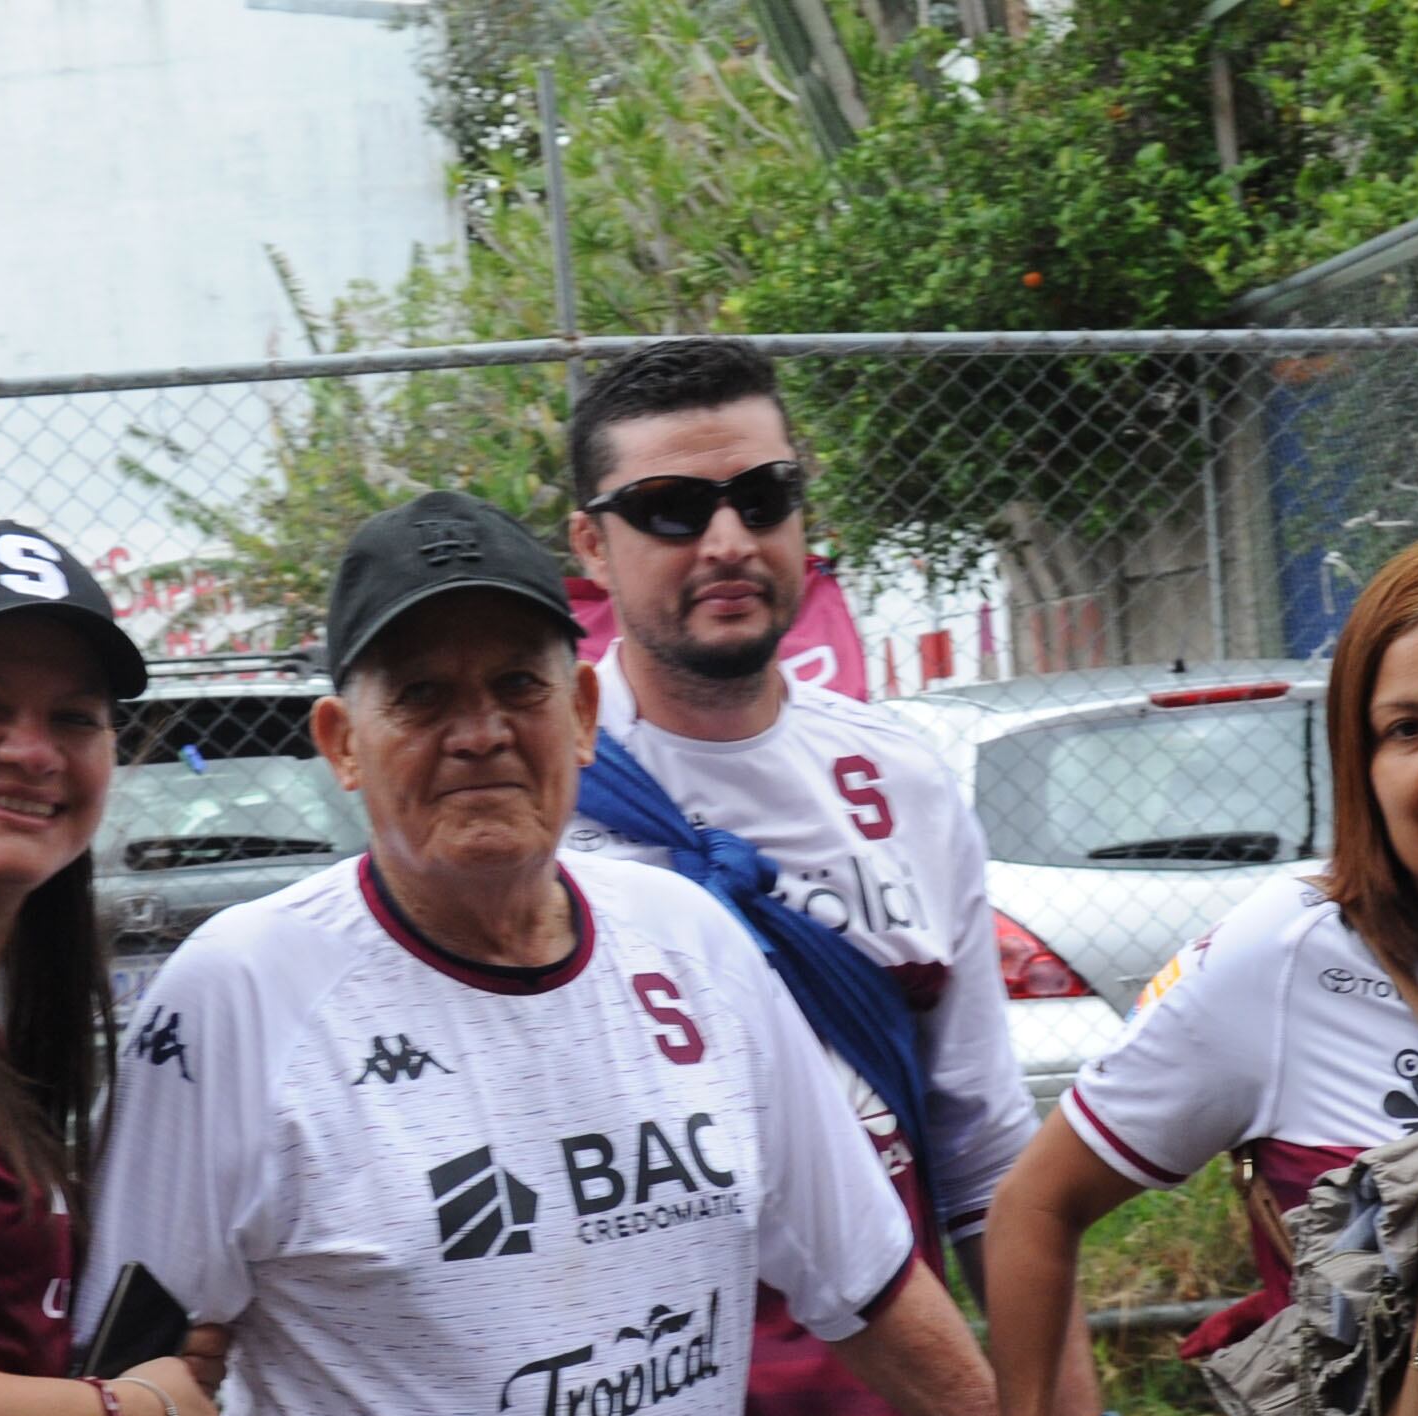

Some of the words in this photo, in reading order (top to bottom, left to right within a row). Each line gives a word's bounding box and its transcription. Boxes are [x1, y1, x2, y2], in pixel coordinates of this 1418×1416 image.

[833, 754, 894, 841] S
[631, 972, 706, 1066] S
[560, 1111, 735, 1217] BAC
[580, 1192, 743, 1245] CREDOMATIC
